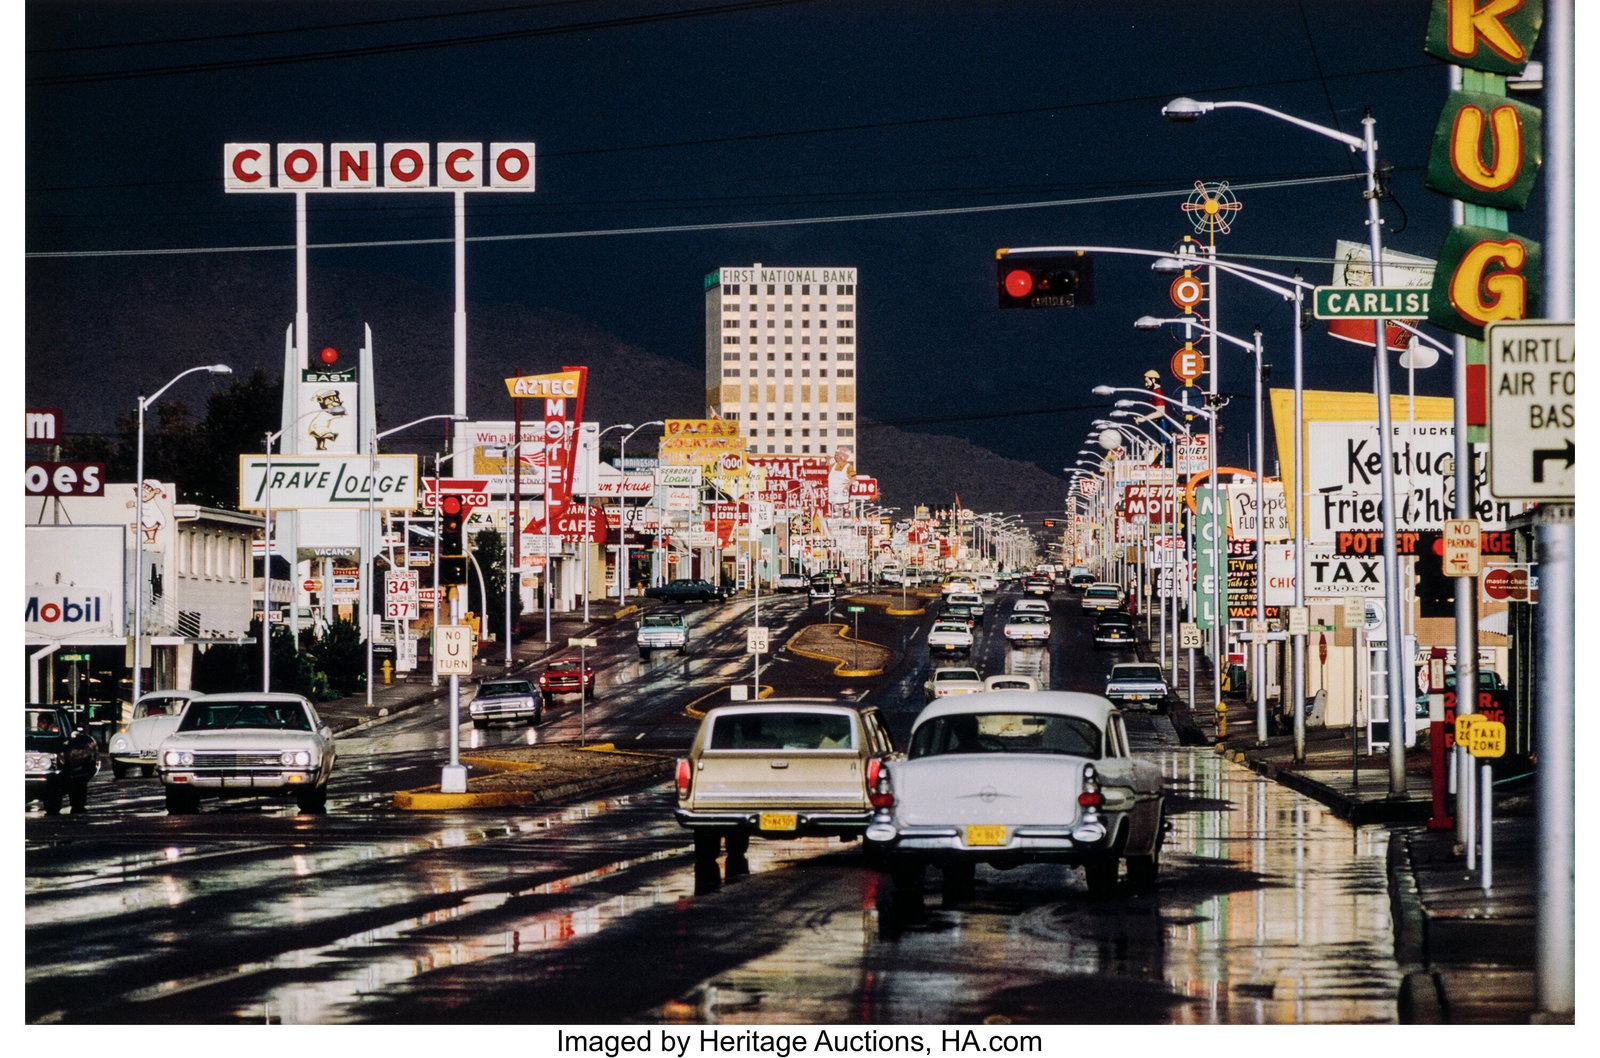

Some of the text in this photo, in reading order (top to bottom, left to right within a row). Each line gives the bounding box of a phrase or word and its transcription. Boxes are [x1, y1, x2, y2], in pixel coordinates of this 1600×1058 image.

[232, 149, 530, 182] CONOCO
[723, 270, 755, 282] FIRST
[761, 270, 817, 282] NATIONAL
[824, 270, 855, 282] BANK
[306, 373, 351, 382] EAST
[514, 378, 576, 396] AZTEC
[1499, 372, 1534, 396] AIR
[1377, 427, 1456, 435] TE UCKE
[477, 432, 498, 442] Win
[546, 398, 565, 506] MOTEL
[1347, 438, 1488, 486] Kentucy
[1402, 487, 1510, 525] Chen
[558, 519, 596, 532] CAFE
[1239, 516, 1275, 530] FLOER
[1454, 524, 1471, 535] NO
[558, 534, 595, 542] PIZZA
[1339, 532, 1420, 553] POTER
[1447, 538, 1477, 548] PARKING
[314, 548, 356, 556] VACANCY
[1201, 496, 1224, 622] MOTEL
[1310, 561, 1381, 582] TAX
[1453, 563, 1470, 572] TIME
[389, 581, 409, 594] 34
[389, 603, 409, 617] 37
[1229, 607, 1278, 617] VACACY
[446, 632, 461, 640] NO
[1183, 635, 1199, 646] 35
[447, 644, 459, 656] U
[750, 640, 766, 650] 35
[440, 660, 467, 669] TURN
[1473, 729, 1502, 738] TAXI
[1473, 741, 1500, 751] ZONE
